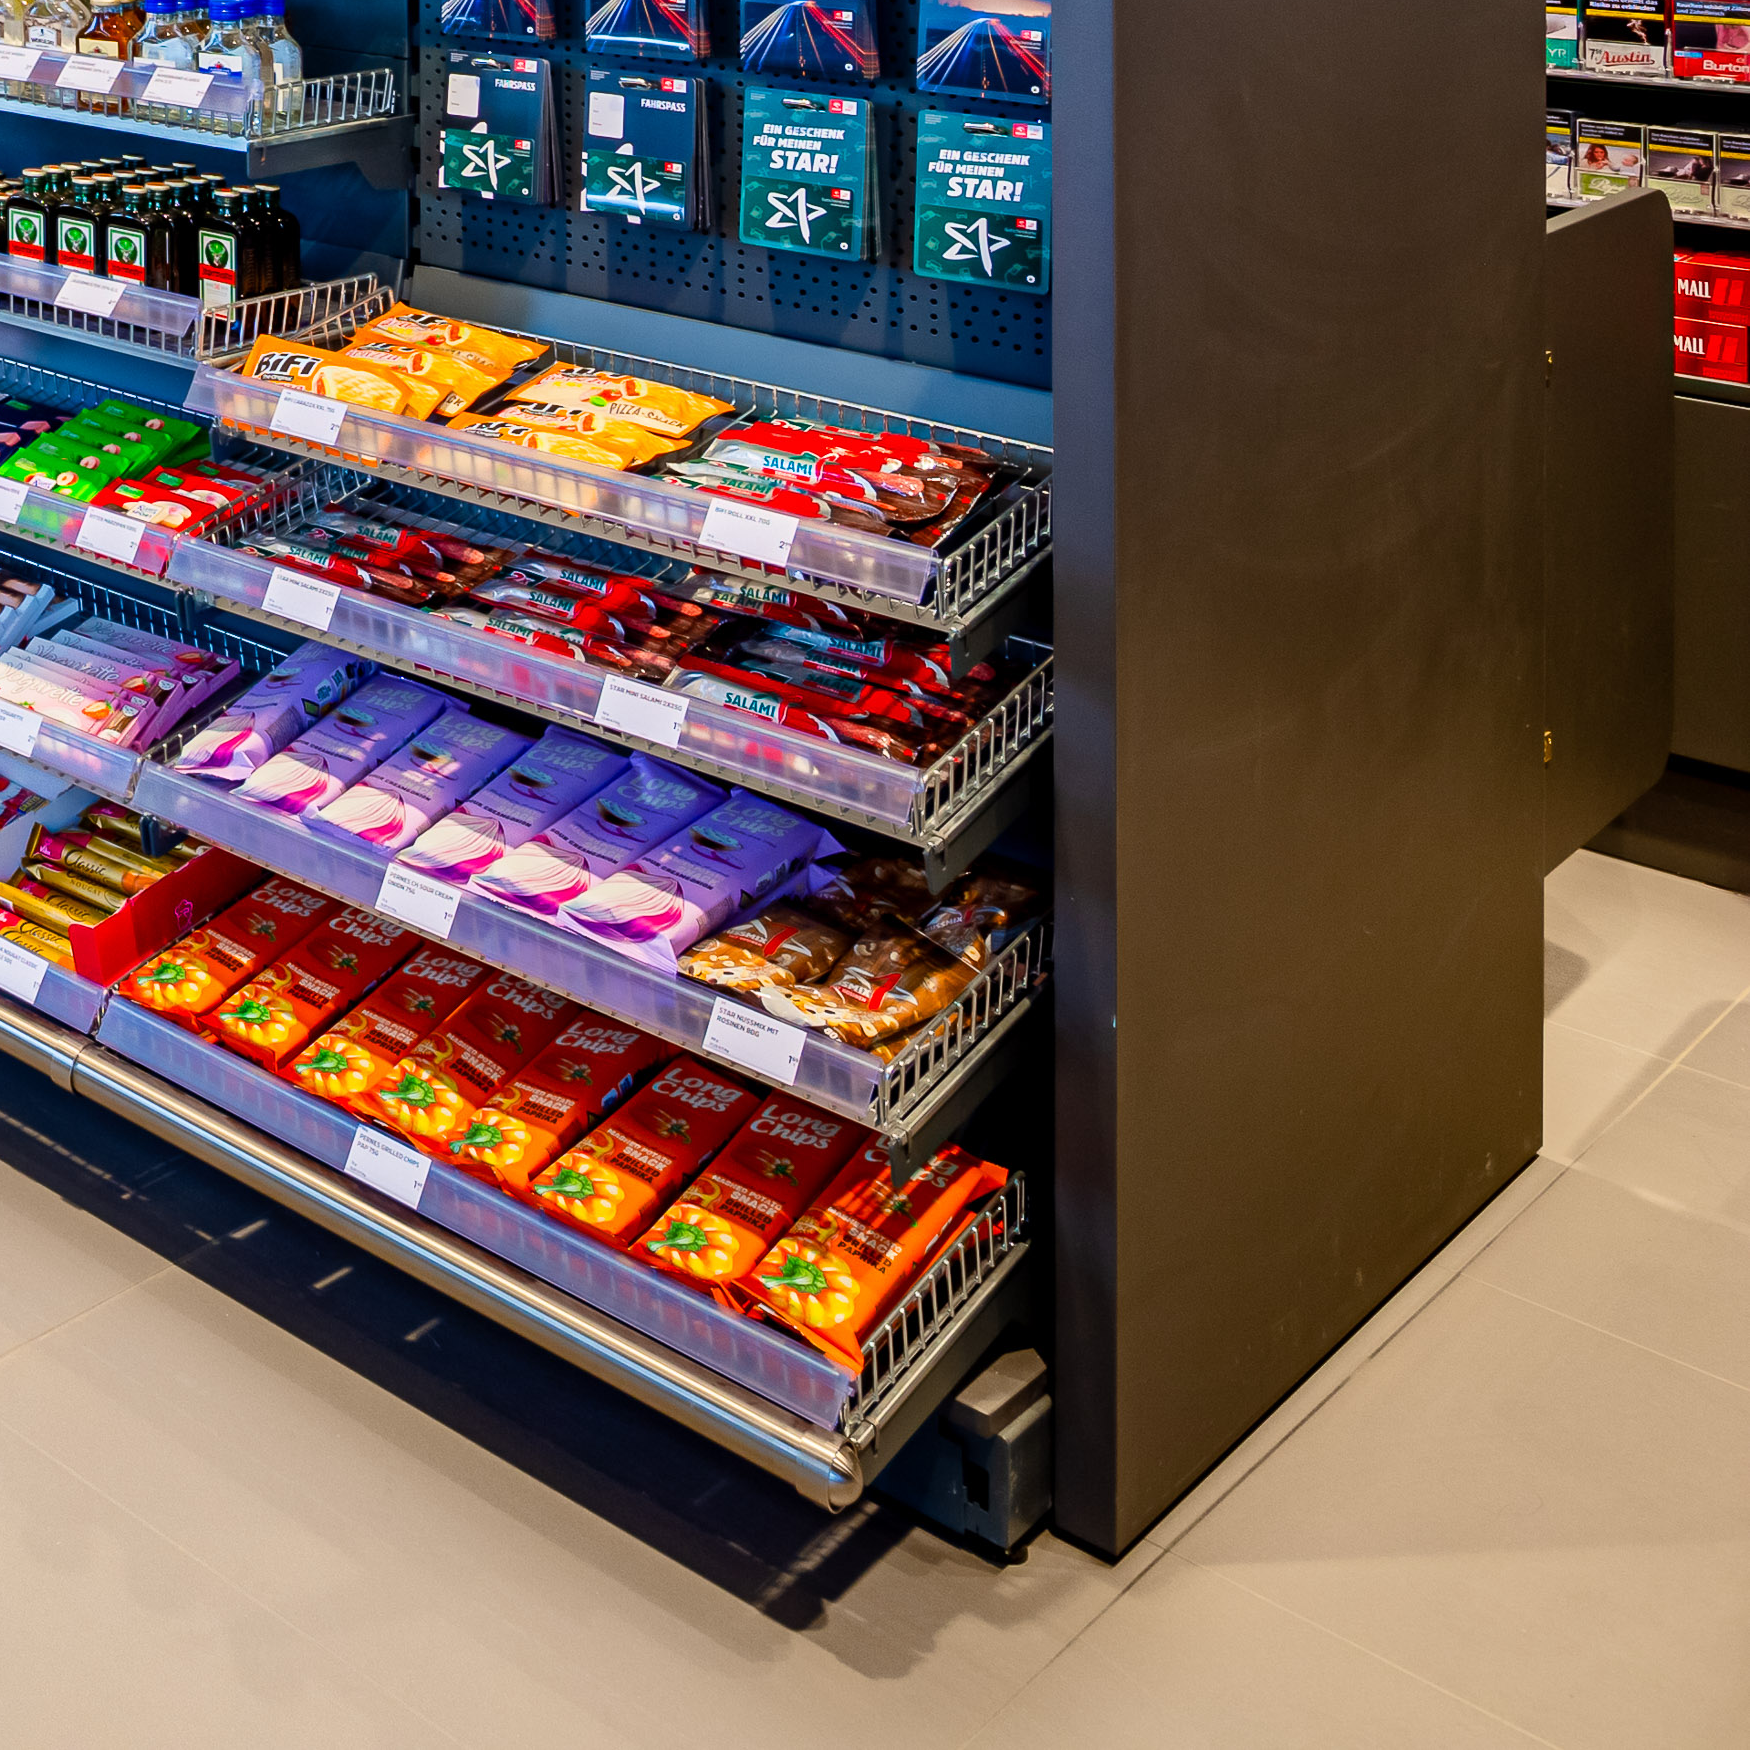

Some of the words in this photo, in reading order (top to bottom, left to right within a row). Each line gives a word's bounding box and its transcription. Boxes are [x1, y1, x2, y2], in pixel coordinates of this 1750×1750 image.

[1600, 49, 1654, 65] Austin
[495, 79, 536, 91] FAHRSPASS
[641, 99, 686, 112] FAHRSPASS
[753, 135, 776, 146] FÜR
[778, 137, 821, 150] MEINEN
[763, 124, 783, 133] EIN
[785, 125, 845, 140] GESCHENK
[770, 150, 839, 174] STAR!
[928, 161, 953, 173] FÜR
[956, 164, 1005, 177] MEINEN
[939, 150, 961, 159] EIN
[964, 151, 1030, 166] GESCHENK
[947, 177, 1023, 202] STAR!
[1678, 280, 1711, 299] MALL
[255, 352, 321, 376] BiFi
[763, 456, 812, 476] SALAMI
[356, 525, 398, 544] SALAMI
[561, 570, 606, 591] SALAMI
[725, 693, 776, 717] SALAMI
[65, 850, 107, 875] Classic
[69, 880, 101, 896] NOUGAT
[20, 920, 63, 942] Classic
[568, 1021, 640, 1044] Long
[717, 1016, 745, 1032] ROSINEN
[719, 1008, 736, 1017] STAR
[736, 1012, 765, 1031] NUSSMIX
[767, 1027, 778, 1035] MIT
[556, 1032, 626, 1056] Chips
[664, 1068, 743, 1098] Long
[652, 1080, 728, 1112] Chips
[761, 1104, 842, 1138] Long
[751, 1119, 830, 1150] Chips
[726, 1198, 772, 1226] GRILLED
[731, 1191, 776, 1218] SNACK
[719, 1205, 766, 1231] PAPRIKA
